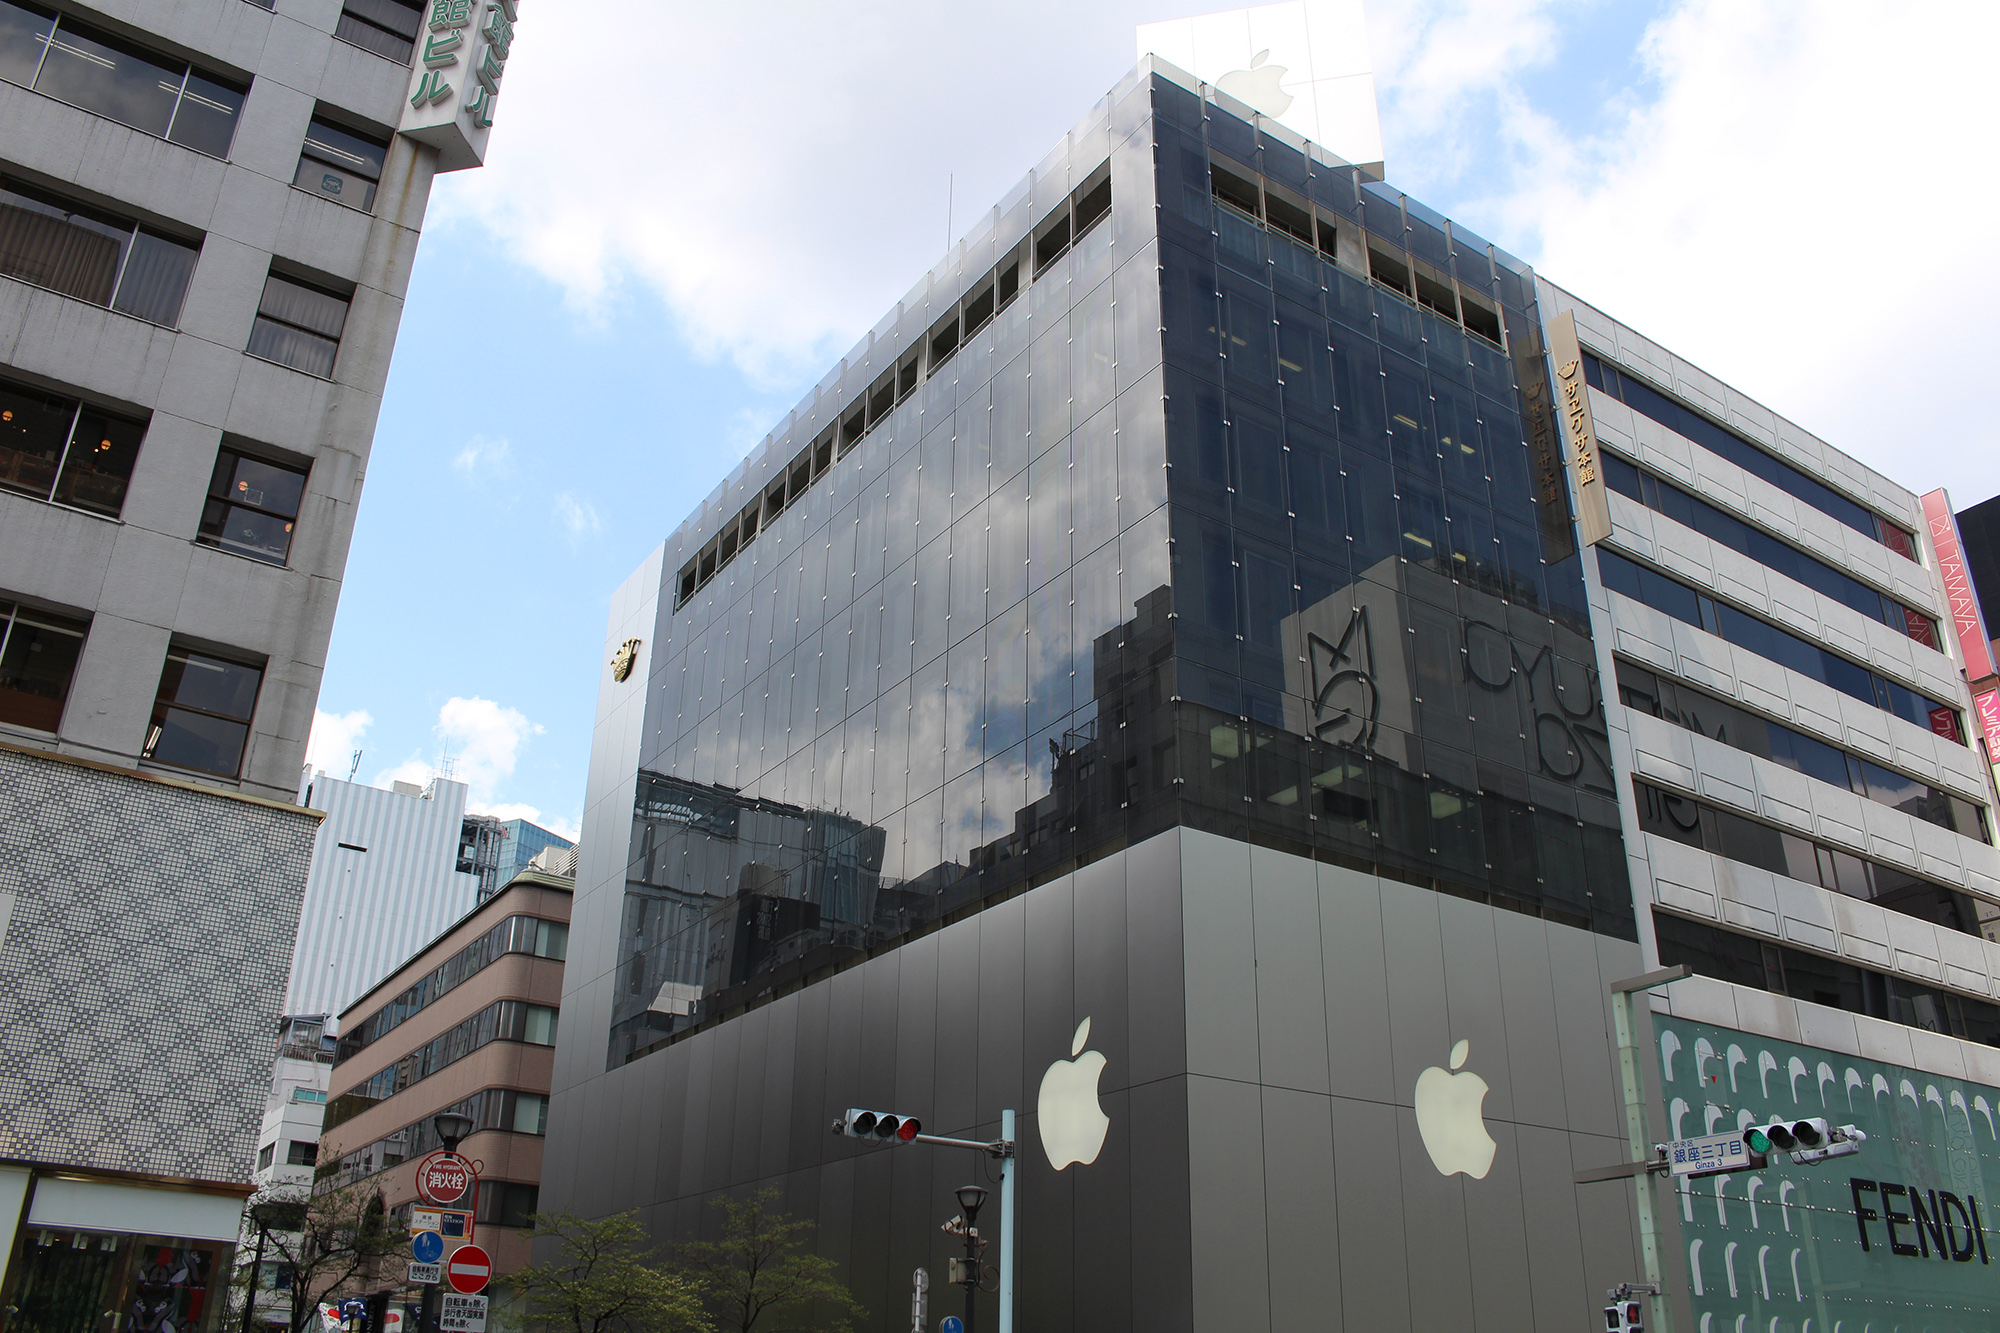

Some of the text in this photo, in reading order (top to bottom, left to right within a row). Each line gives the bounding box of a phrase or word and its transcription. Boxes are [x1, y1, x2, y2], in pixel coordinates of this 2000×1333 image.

[1940, 549, 1977, 637] TAMAYA
[1672, 1140, 1694, 1148] 中央区
[1674, 1140, 1742, 1163] 銀座三丁目
[1695, 1158, 1723, 1169] Ginza 3
[429, 1171, 464, 1189] 消火栓
[1850, 1177, 1988, 1265] FENDI
[411, 1273, 437, 1281] ここから
